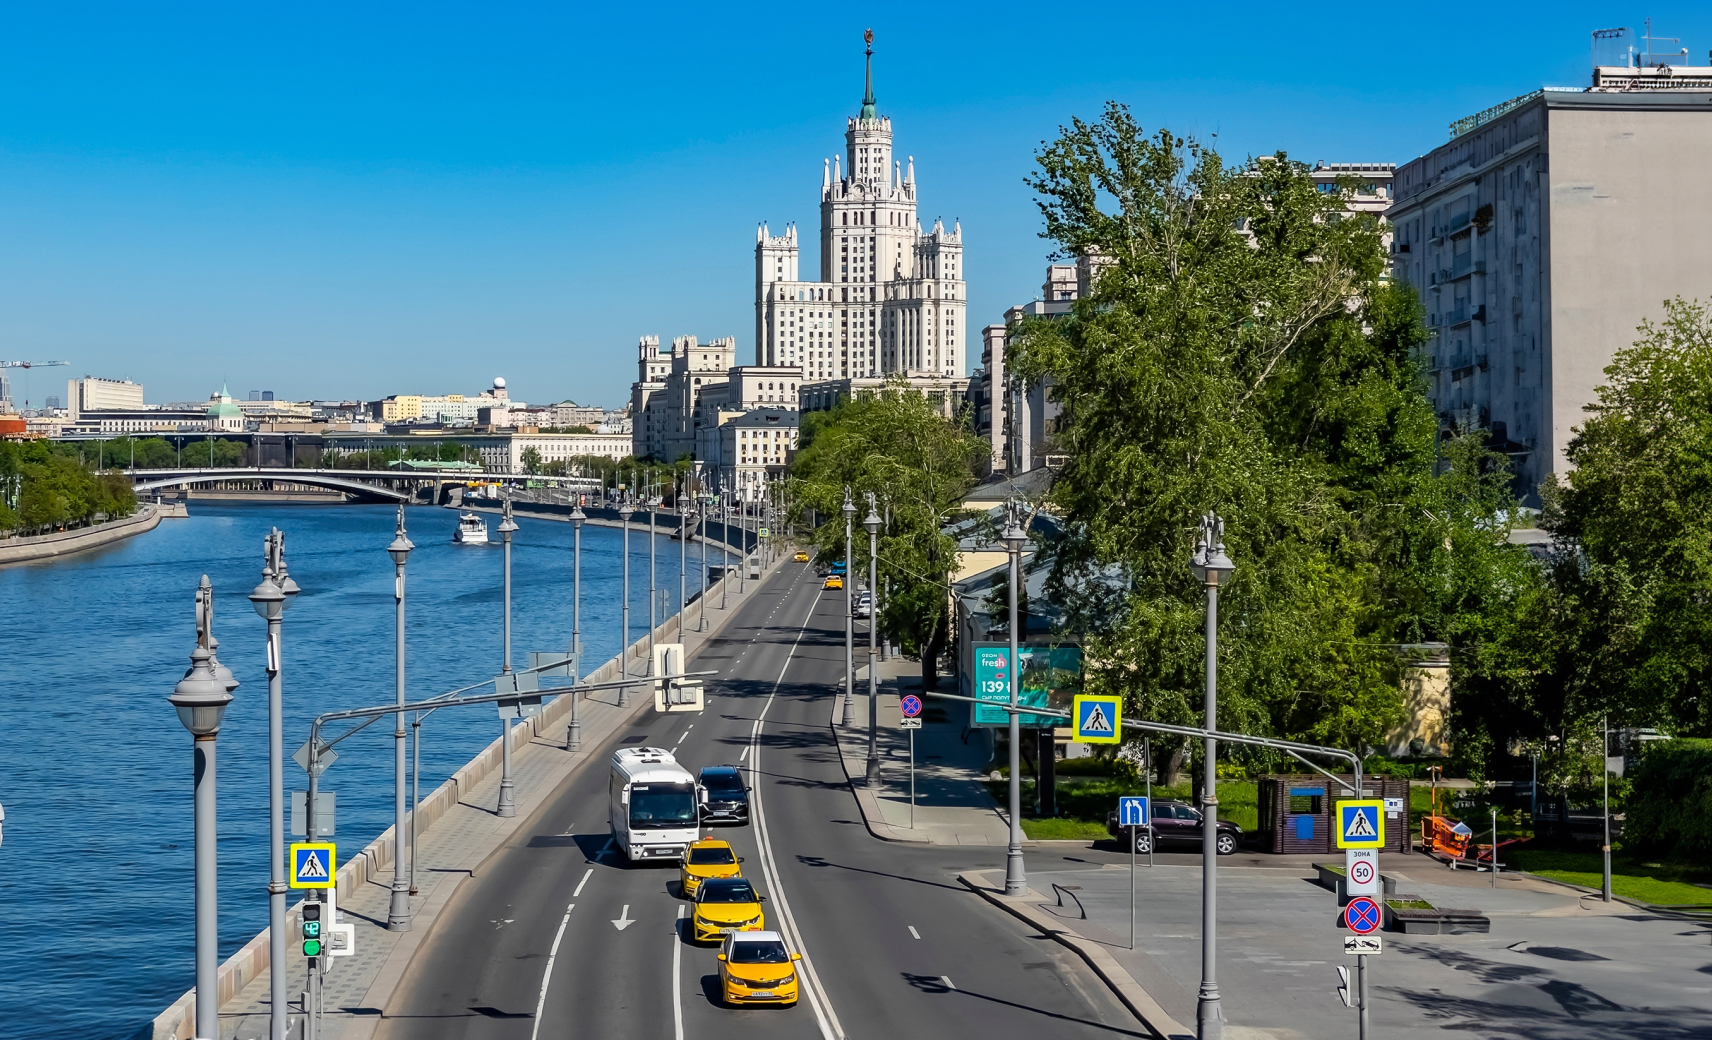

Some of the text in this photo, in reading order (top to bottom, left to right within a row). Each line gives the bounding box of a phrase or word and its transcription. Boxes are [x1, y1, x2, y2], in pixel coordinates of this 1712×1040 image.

[981, 658, 1005, 667] fresh
[981, 680, 1004, 693] 139
[1356, 868, 1369, 877] 50
[304, 922, 319, 935] 42
